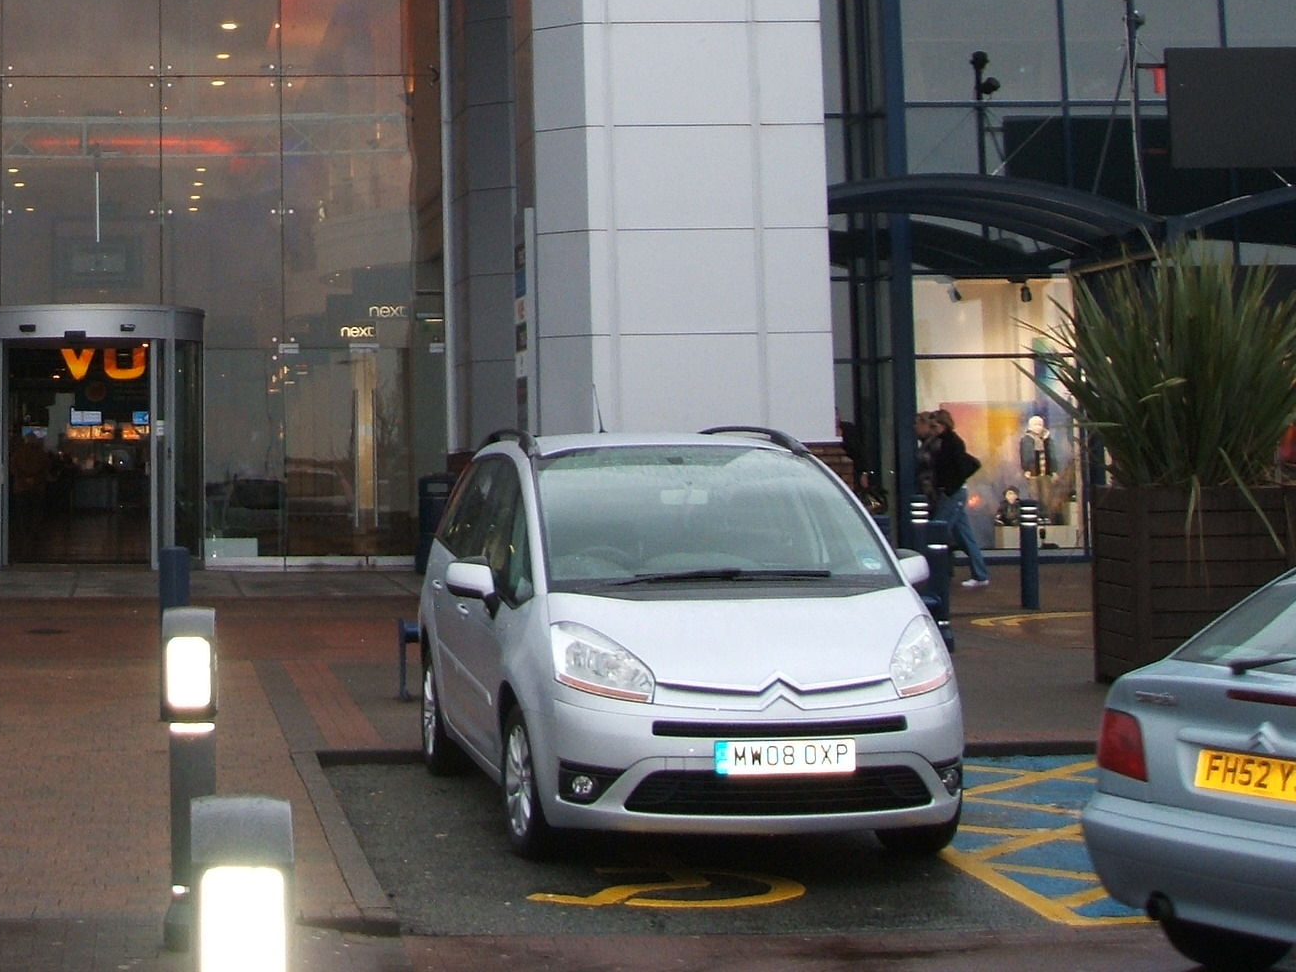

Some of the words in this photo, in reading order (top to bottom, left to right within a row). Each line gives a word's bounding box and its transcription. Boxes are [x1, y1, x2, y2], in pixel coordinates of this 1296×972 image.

[368, 304, 407, 318] next
[340, 326, 375, 338] next
[734, 745, 795, 766] MW08
[1205, 754, 1271, 789] FH52
[1279, 763, 1296, 792] Y
